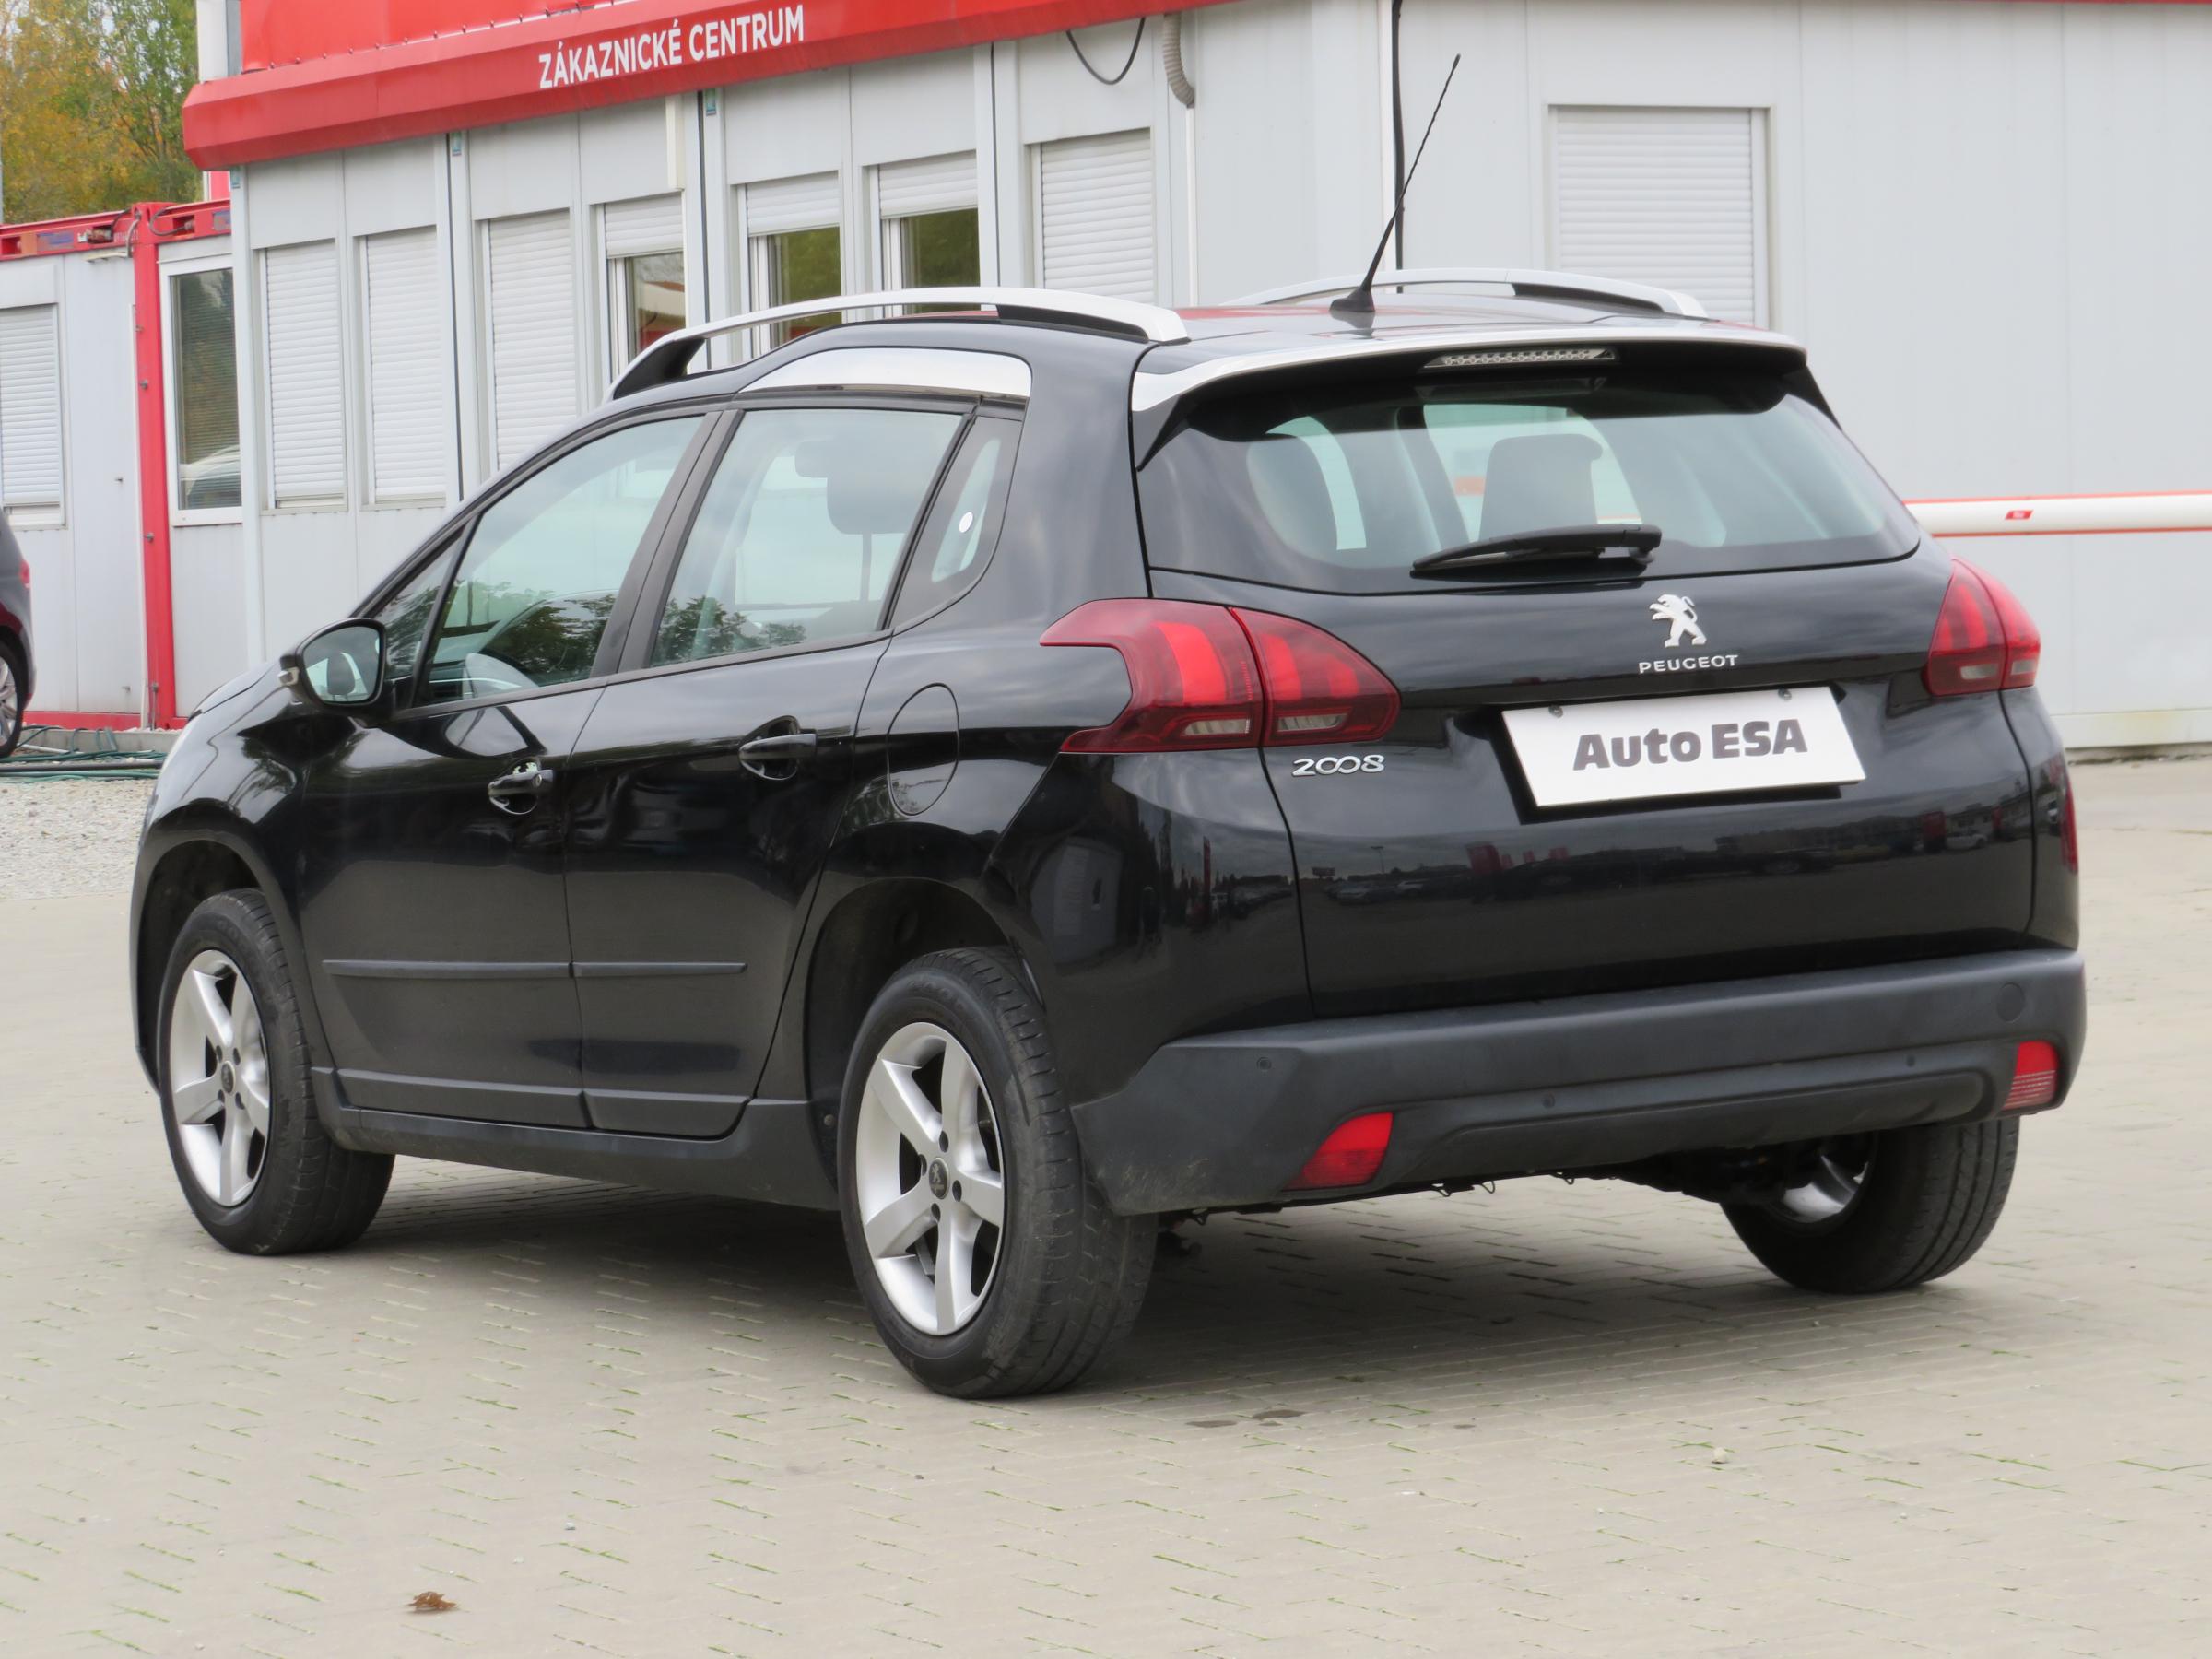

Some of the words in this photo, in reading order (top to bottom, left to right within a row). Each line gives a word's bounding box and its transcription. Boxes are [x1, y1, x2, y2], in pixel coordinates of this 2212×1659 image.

[538, 18, 682, 89] ZÁKAZNICKÉ
[688, 4, 805, 62] CENTRUM
[1638, 654, 1739, 674] PEUGEOT
[1572, 728, 1702, 771] Auto
[1711, 719, 1808, 759] ESA
[1292, 754, 1385, 776] 2008
